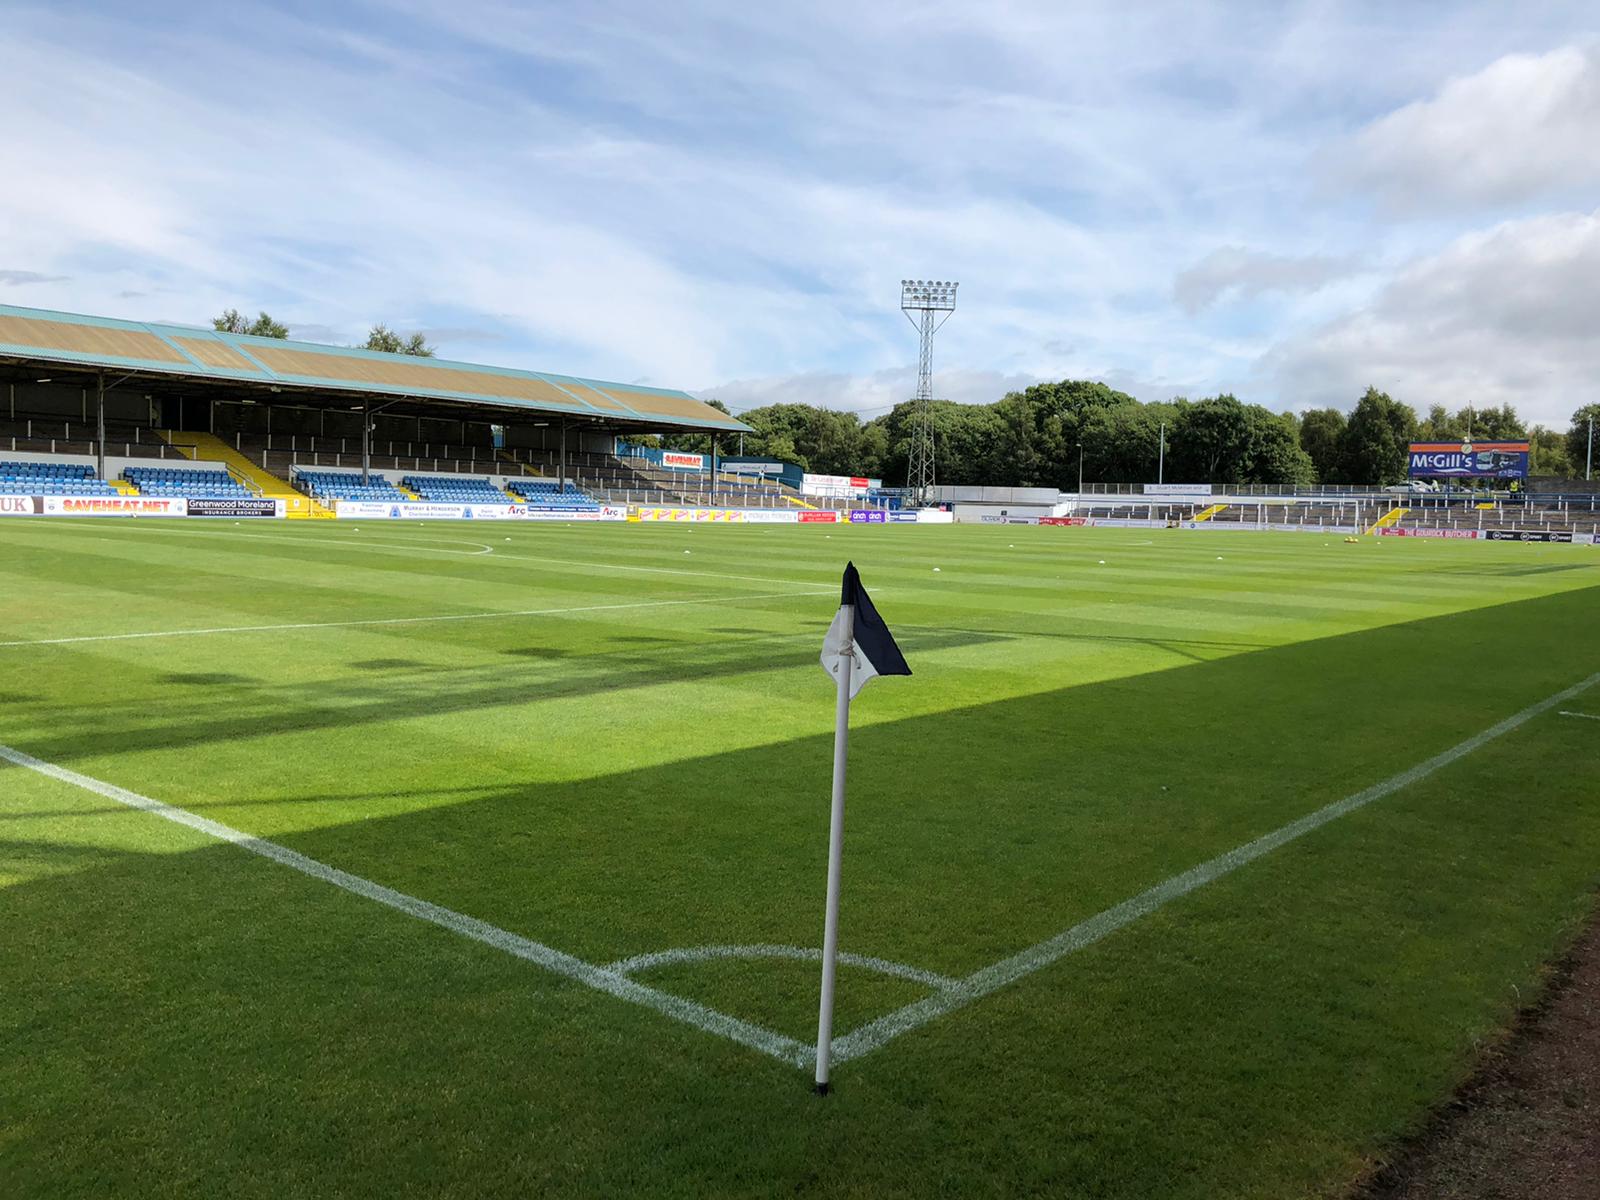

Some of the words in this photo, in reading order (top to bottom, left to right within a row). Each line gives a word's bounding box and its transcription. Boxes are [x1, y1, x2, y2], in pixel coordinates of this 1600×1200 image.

[1412, 454, 1472, 468] McGill's
[63, 499, 170, 512] SAVEHEAT.NET
[188, 500, 237, 509] Greenwood
[238, 500, 274, 509] Moreland
[508, 505, 526, 515] Arc
[602, 506, 618, 516] Arc
